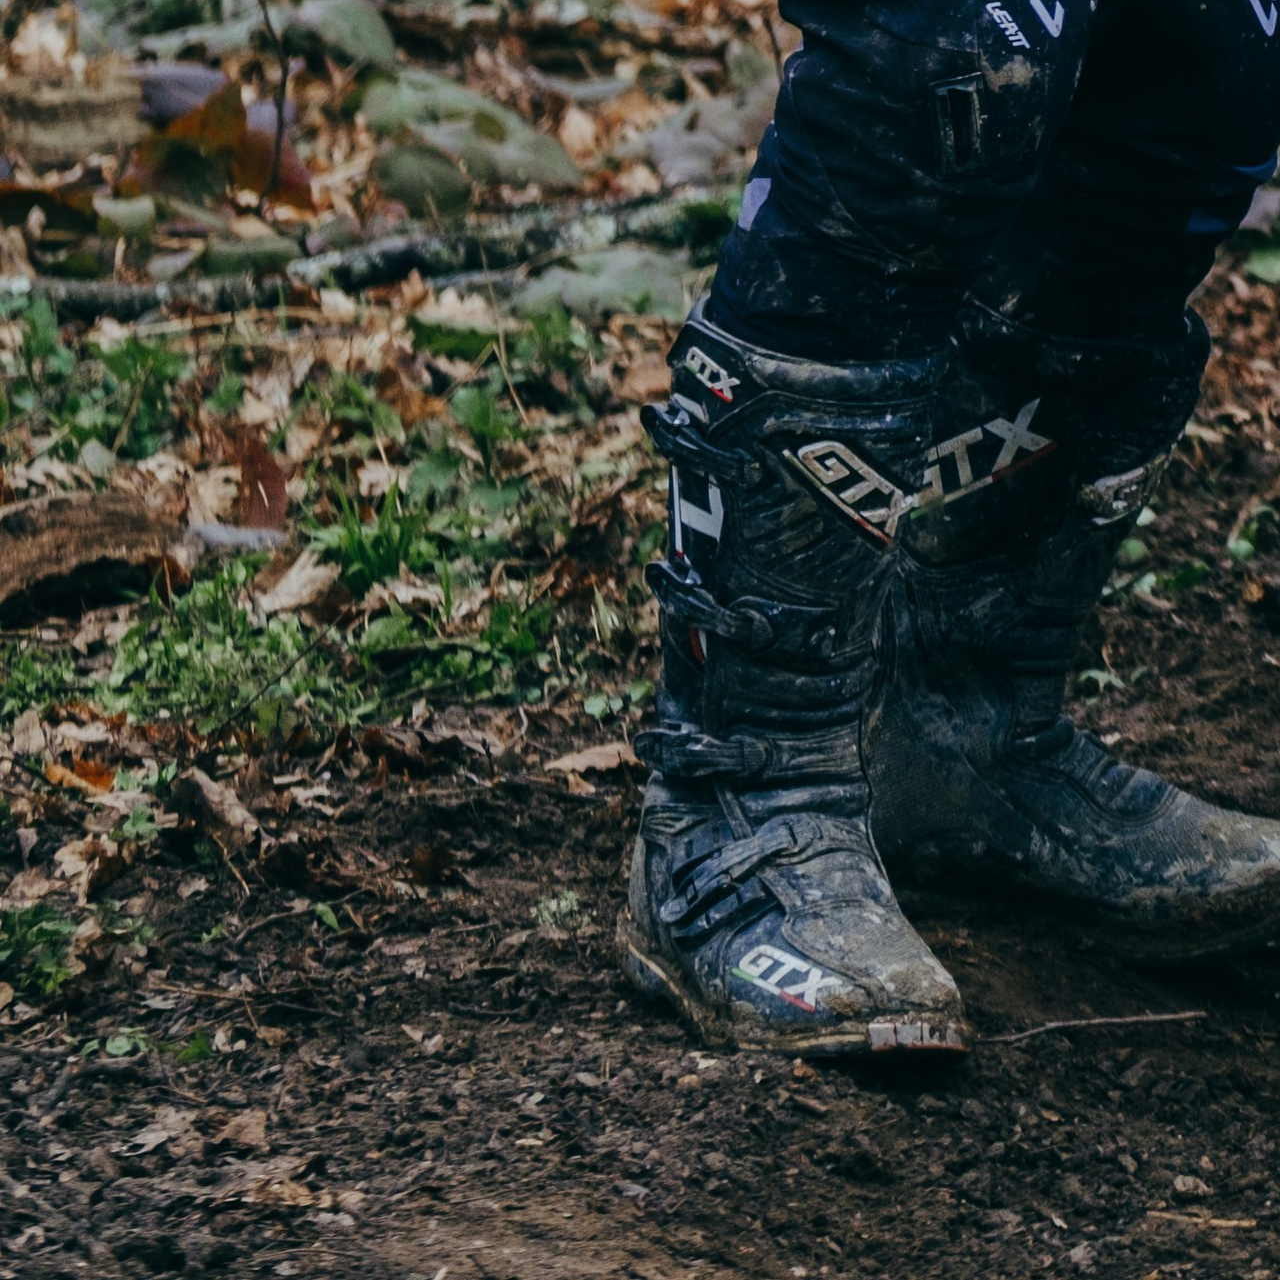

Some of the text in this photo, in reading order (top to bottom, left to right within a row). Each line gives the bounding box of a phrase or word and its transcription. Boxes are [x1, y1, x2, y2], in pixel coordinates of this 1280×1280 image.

[985, 1, 1031, 50] LEATT
[685, 346, 742, 401] GTX
[797, 440, 915, 539] GTX
[738, 943, 844, 1009] GTX
